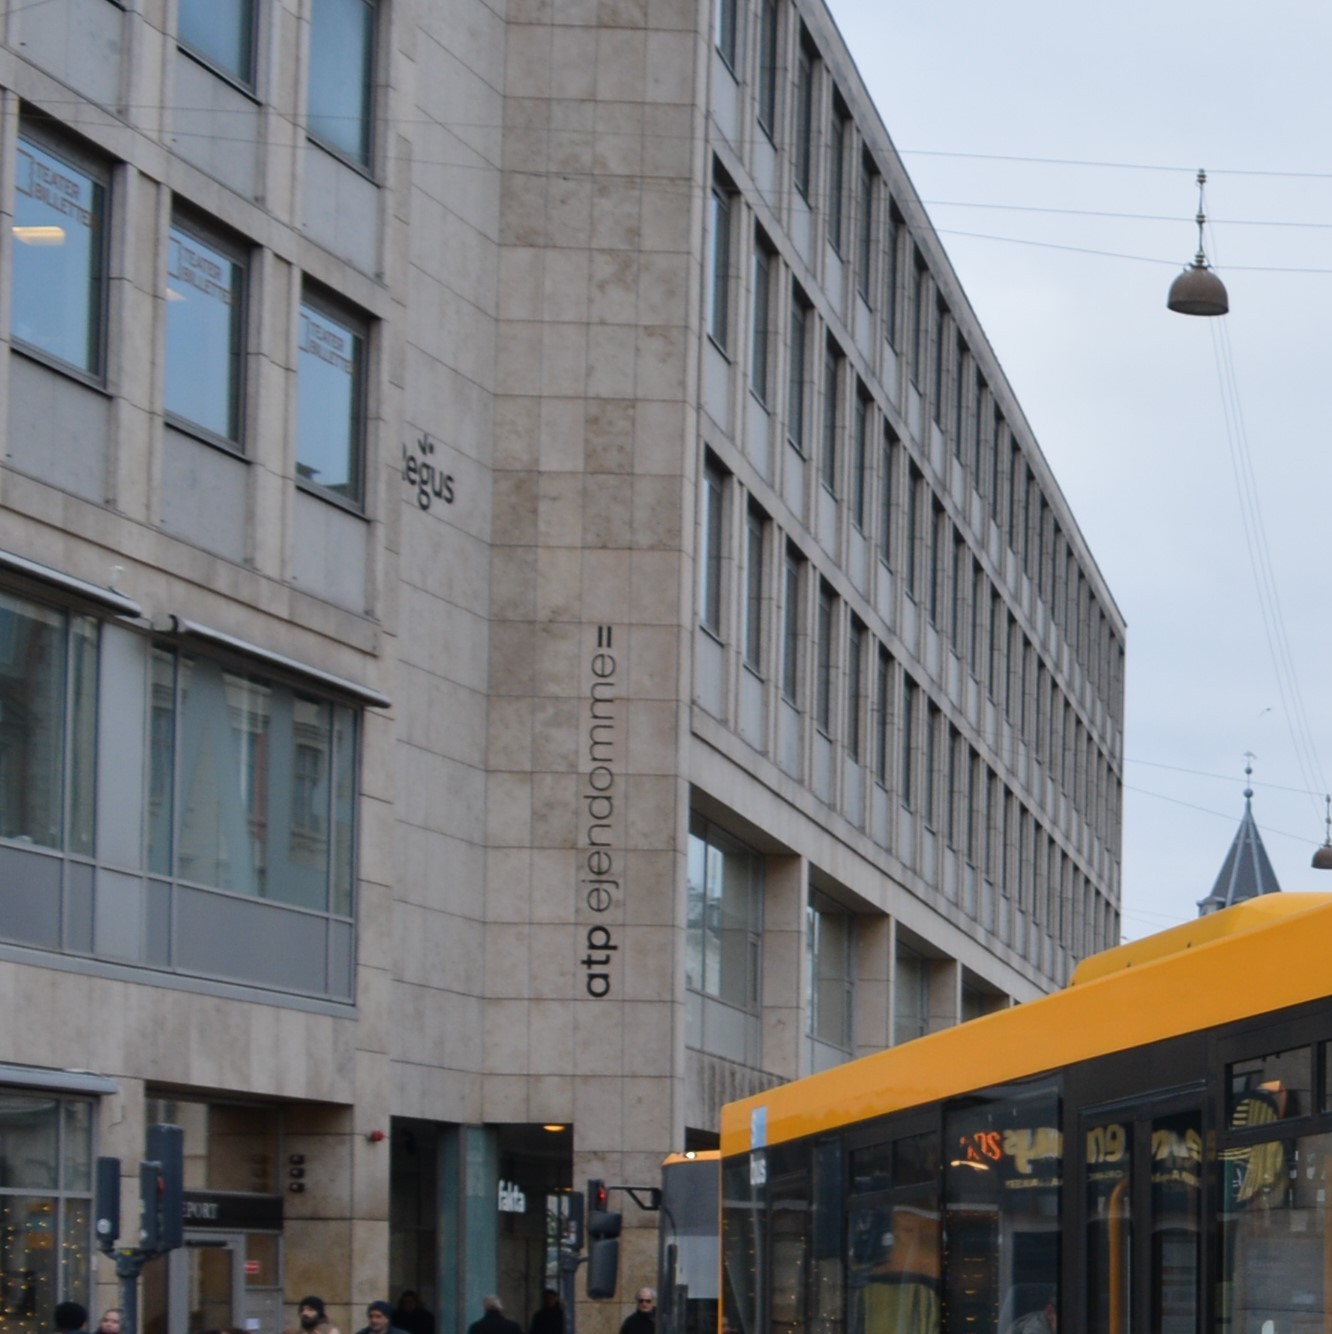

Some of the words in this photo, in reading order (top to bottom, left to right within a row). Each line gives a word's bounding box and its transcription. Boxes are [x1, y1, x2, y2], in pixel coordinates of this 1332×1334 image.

[402, 441, 454, 511] egus
[580, 925, 618, 998] atp
[498, 1179, 526, 1212] fakta
